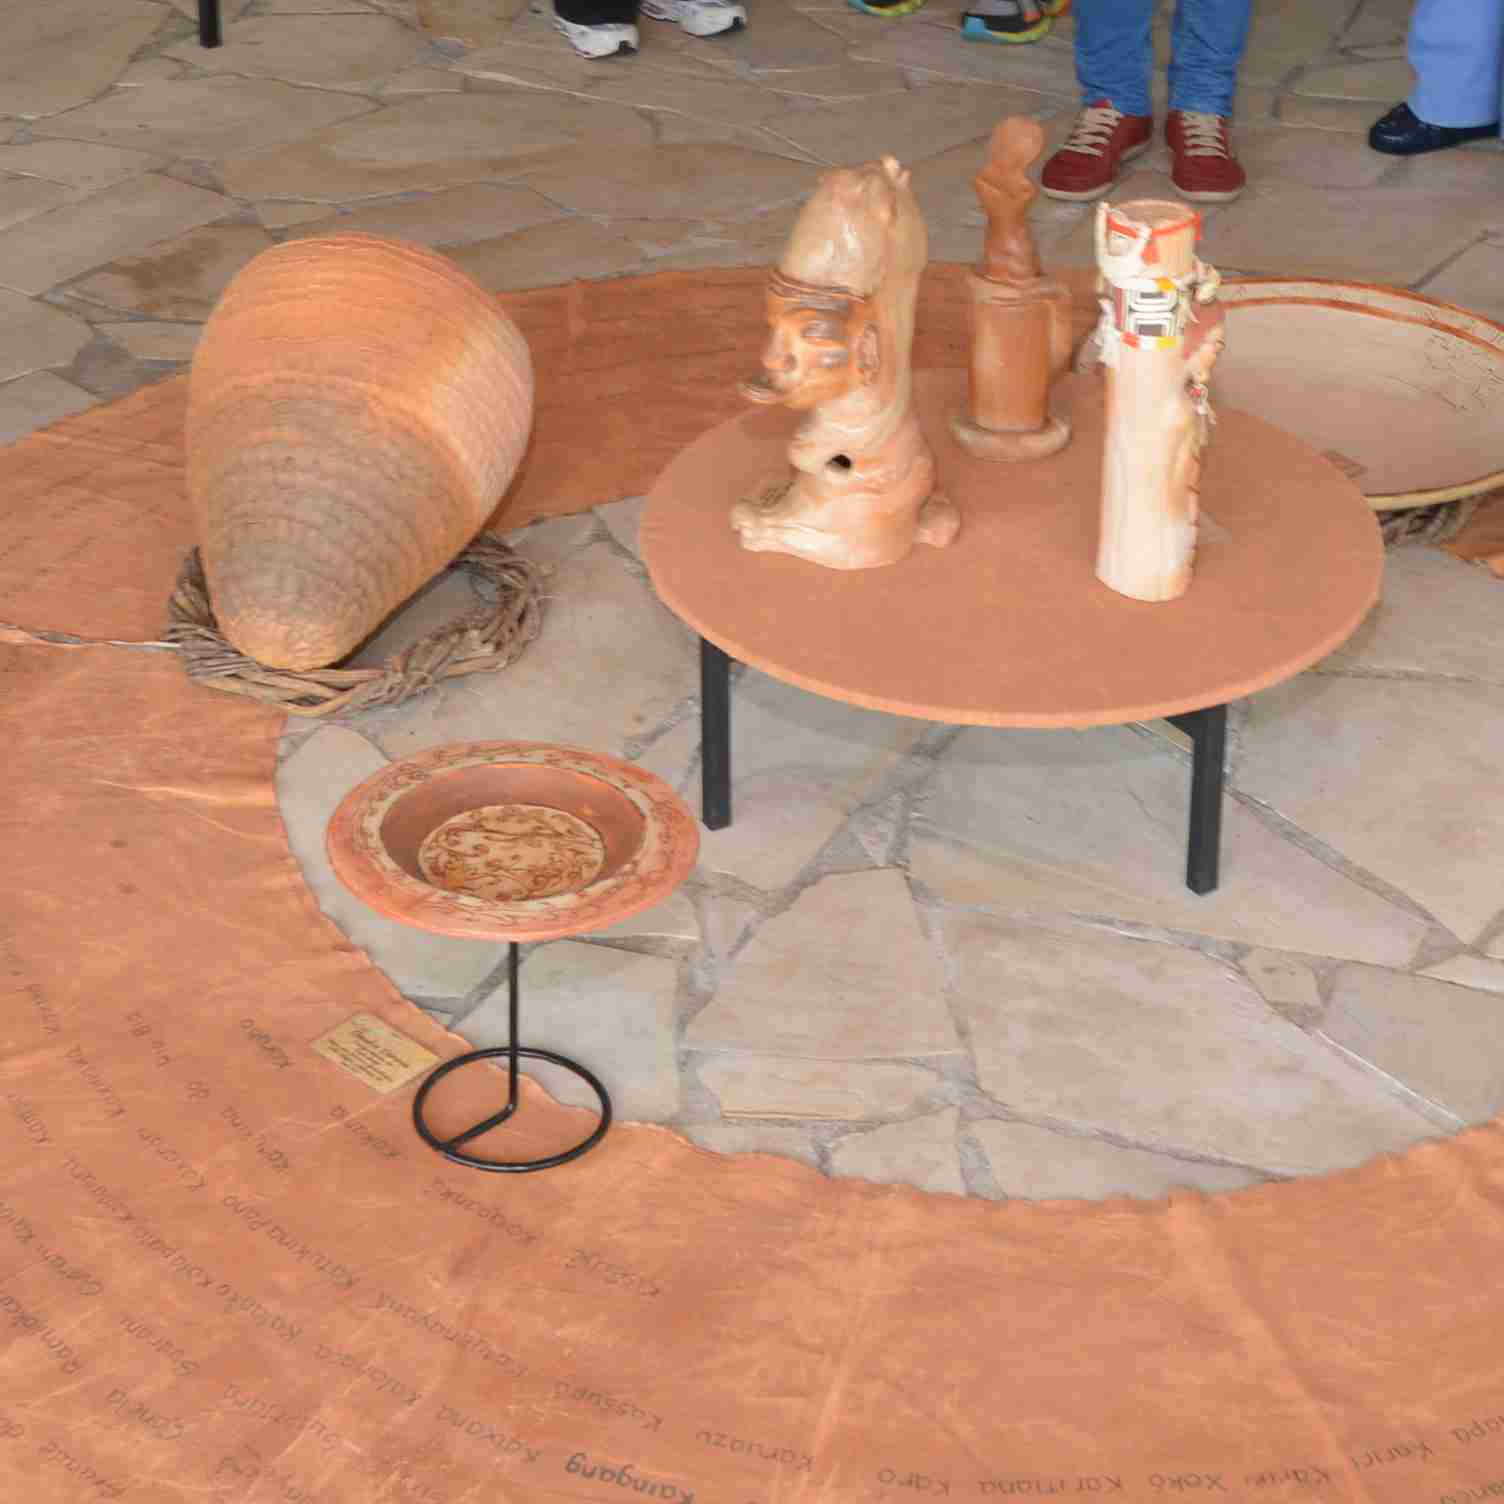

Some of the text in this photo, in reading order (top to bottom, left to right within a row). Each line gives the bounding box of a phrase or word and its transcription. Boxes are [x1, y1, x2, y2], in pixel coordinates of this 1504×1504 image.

[176, 1079, 215, 1101] do
[559, 1452, 697, 1504] Kaingang
[875, 1466, 952, 1496] Karo
